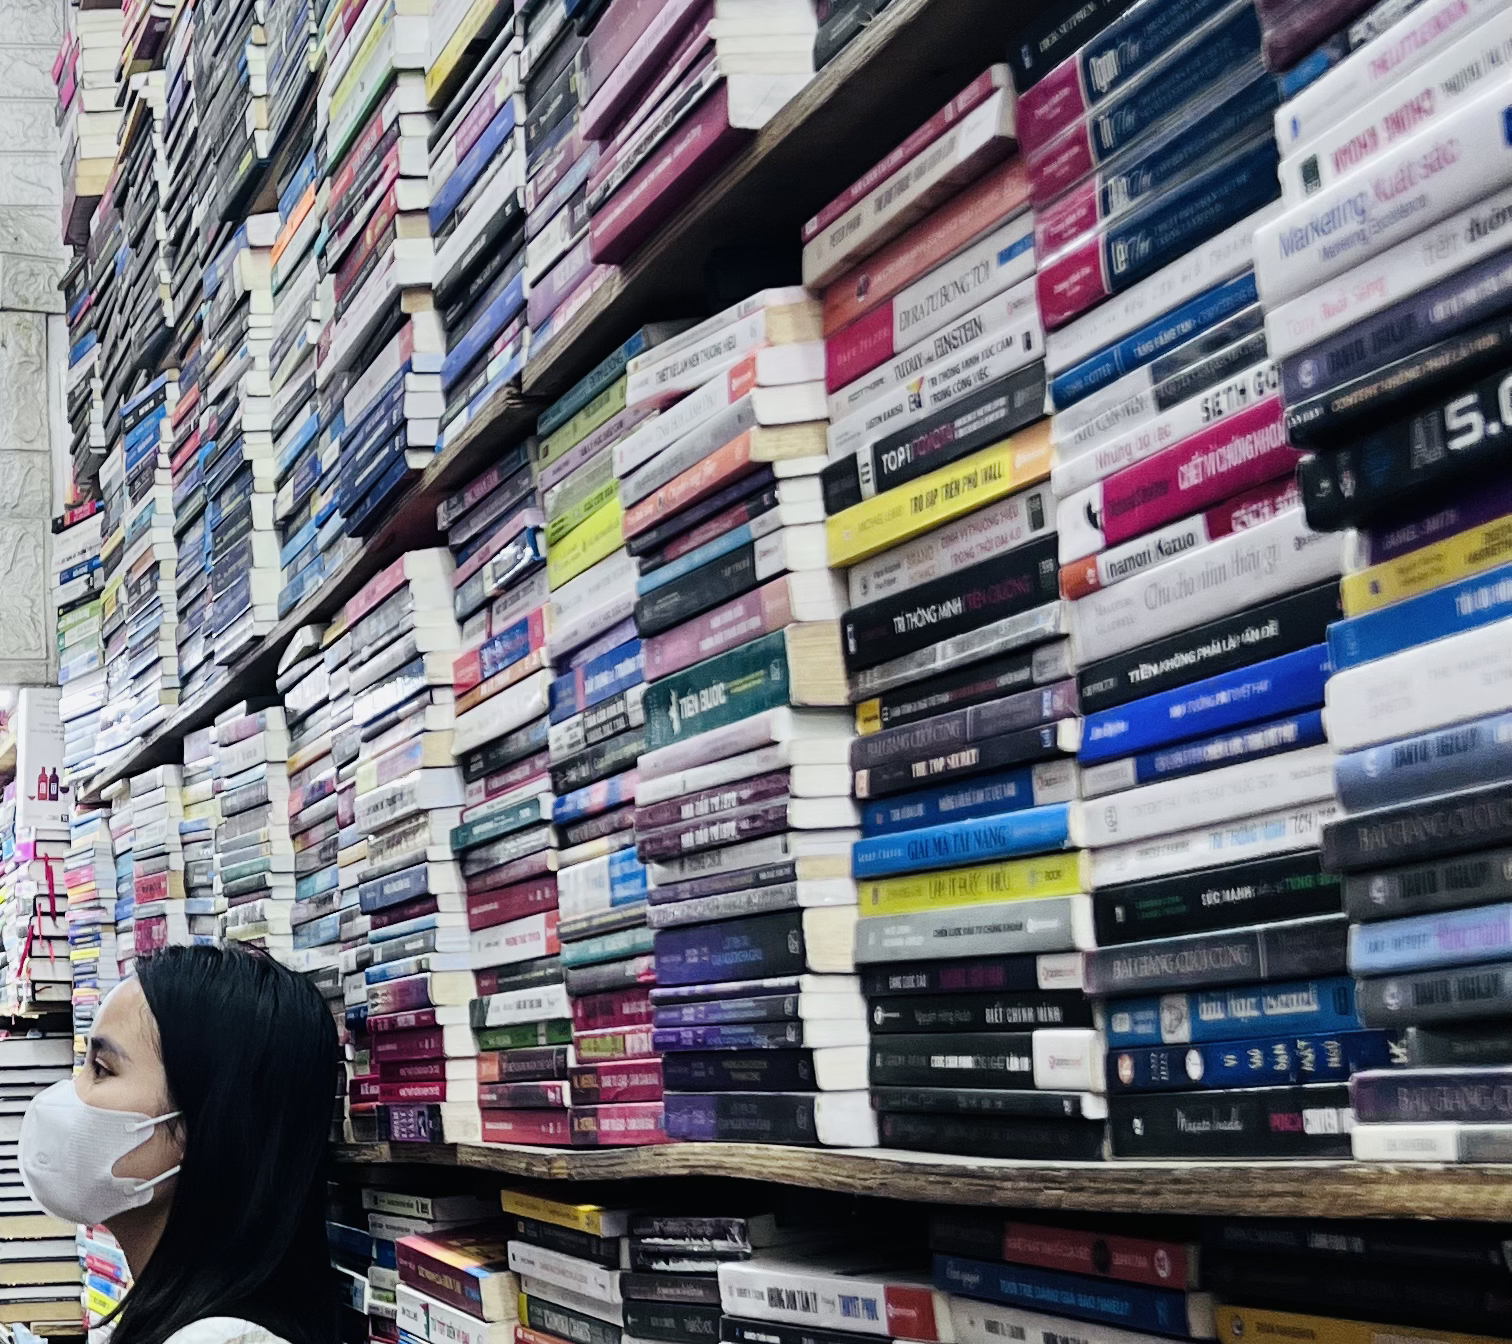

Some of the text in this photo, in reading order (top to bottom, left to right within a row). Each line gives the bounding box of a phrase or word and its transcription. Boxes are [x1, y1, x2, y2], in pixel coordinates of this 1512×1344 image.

[935, 315, 984, 359] EINSTEIN
[1104, 531, 1196, 579] Inamori Kazuo
